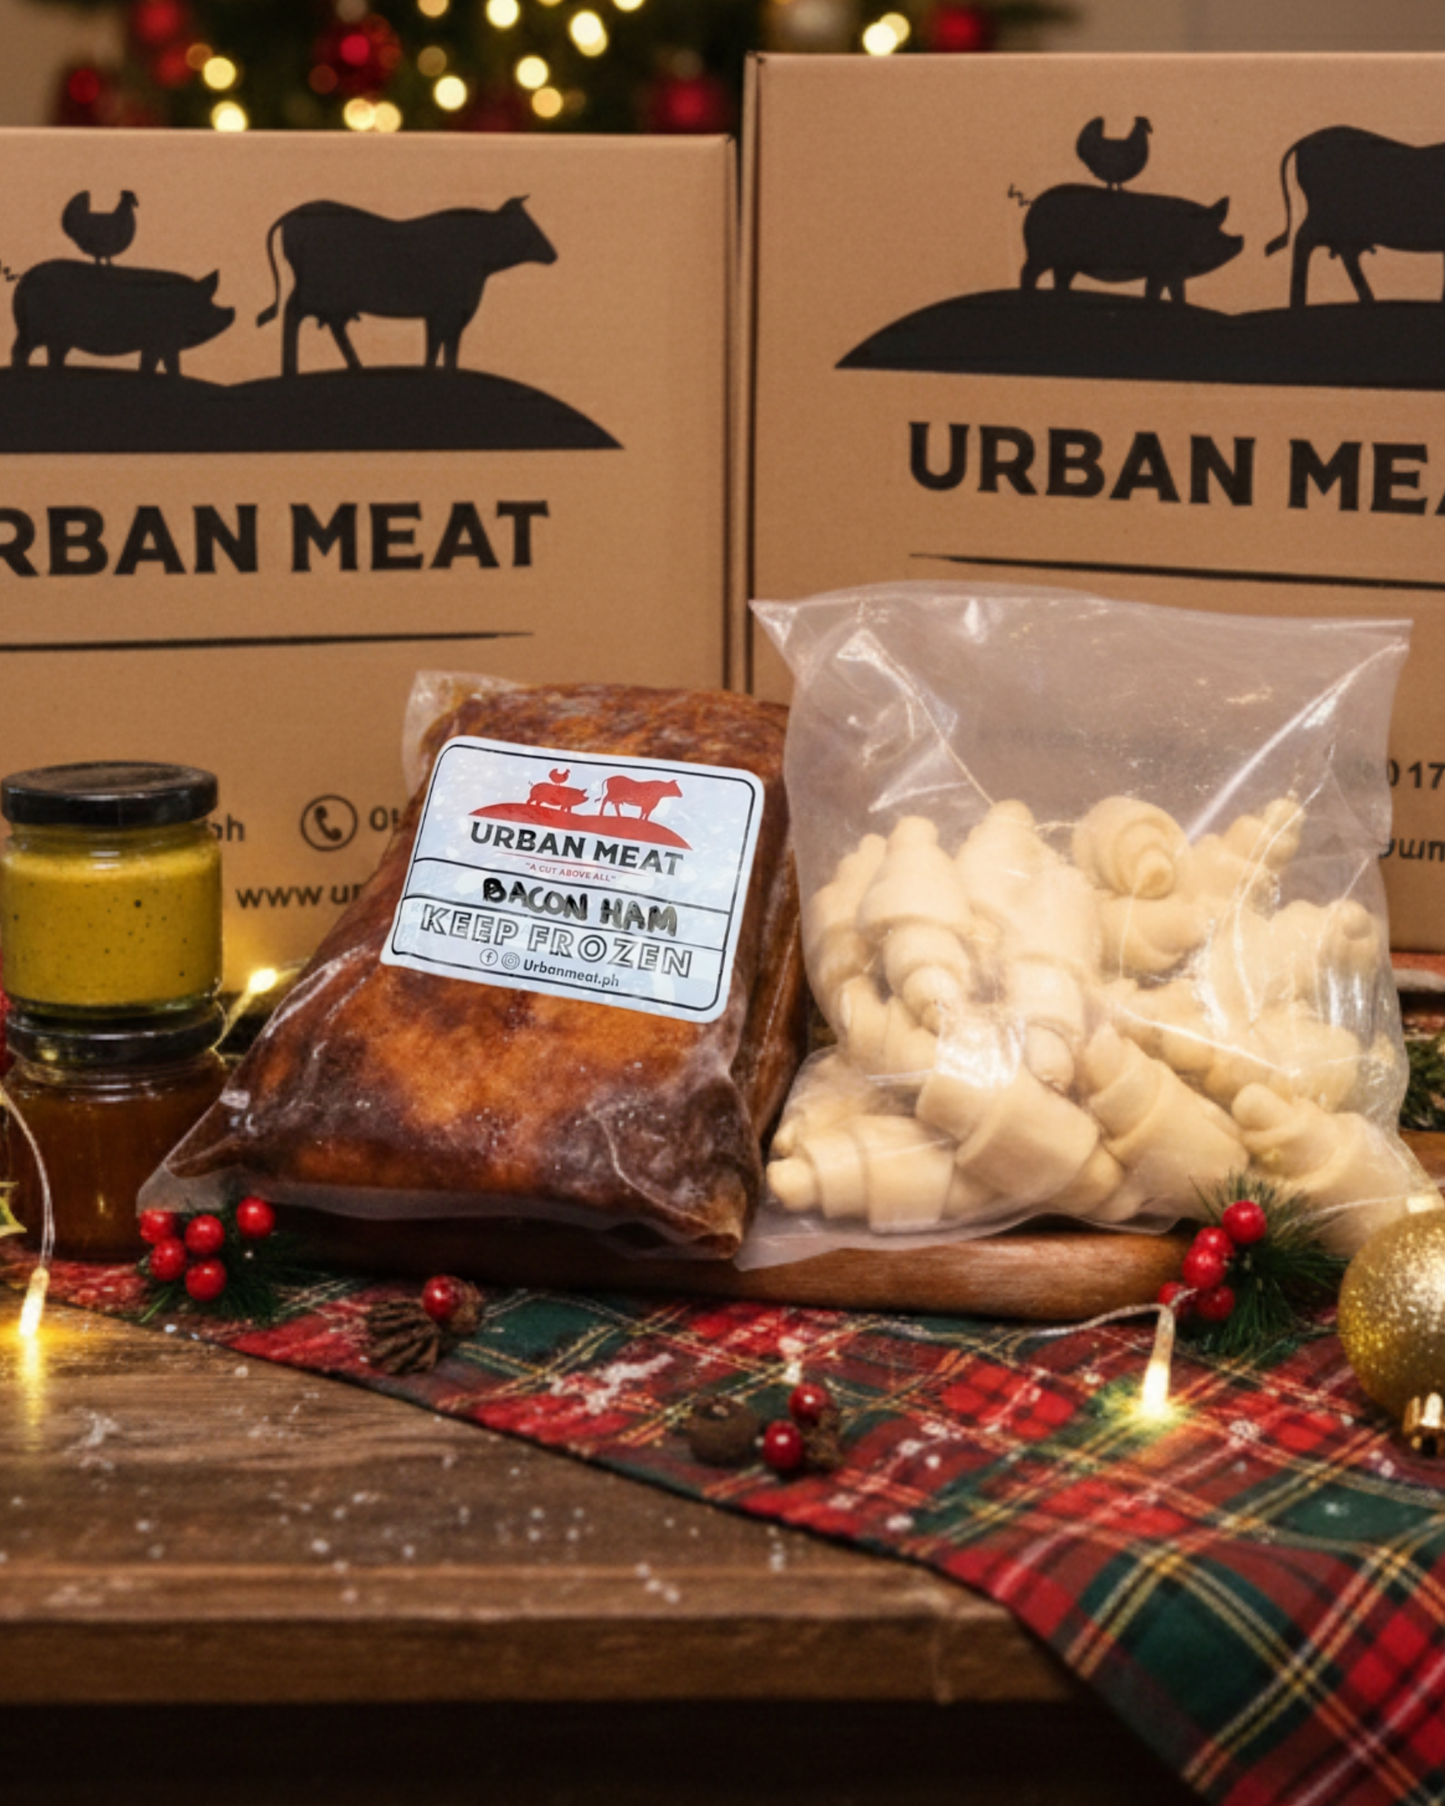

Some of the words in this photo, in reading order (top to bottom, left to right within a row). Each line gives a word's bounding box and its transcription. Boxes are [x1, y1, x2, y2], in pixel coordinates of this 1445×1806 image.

[909, 422, 1256, 506] URBAN
[1288, 439, 1445, 516] ME
[0, 504, 259, 577] RBAN
[290, 500, 549, 573] MEAT
[471, 821, 586, 859] URBAN
[593, 840, 685, 876] MEAT
[538, 865, 557, 875] CUT
[559, 869, 591, 879] ABOVE
[482, 877, 588, 921] BACON
[599, 898, 678, 938] HAM
[420, 903, 519, 946] KEEP
[527, 925, 693, 979] FROZEN
[523, 958, 620, 989] Urbanmeat.ph
